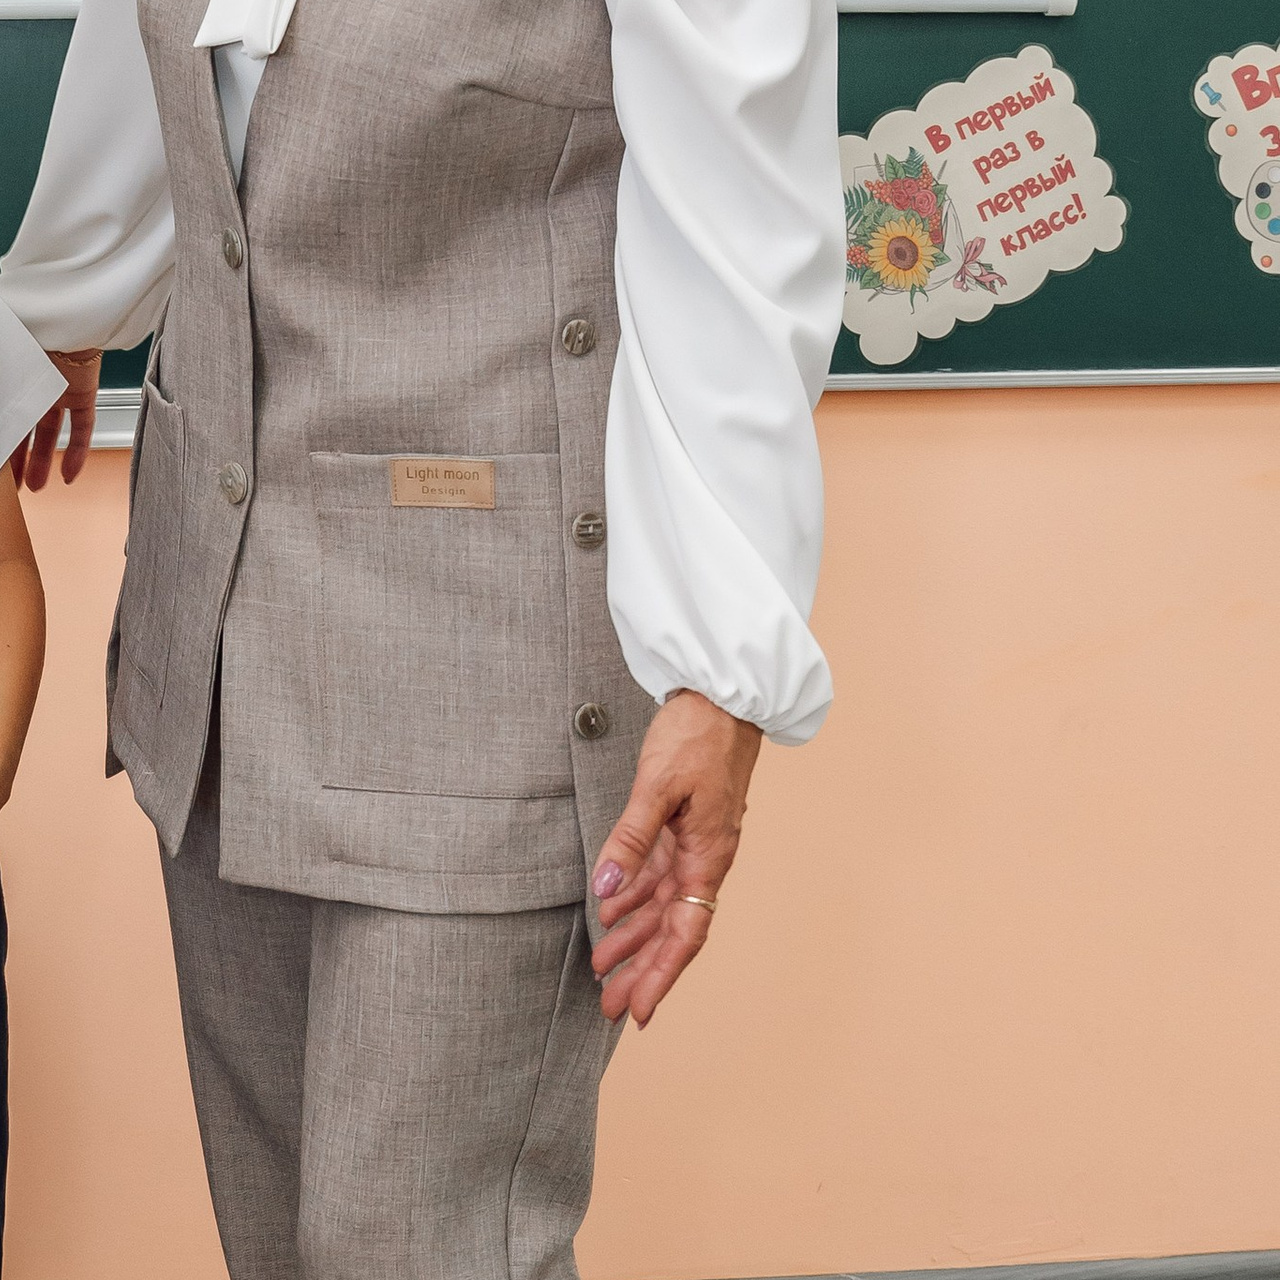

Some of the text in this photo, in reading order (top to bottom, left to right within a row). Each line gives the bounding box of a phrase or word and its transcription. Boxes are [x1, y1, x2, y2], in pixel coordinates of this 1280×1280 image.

[955, 72, 1055, 141] первый
[973, 141, 1020, 184] раз
[977, 154, 1077, 221] первый
[1000, 193, 1087, 256] класс!
[406, 467, 480, 482] Light moon
